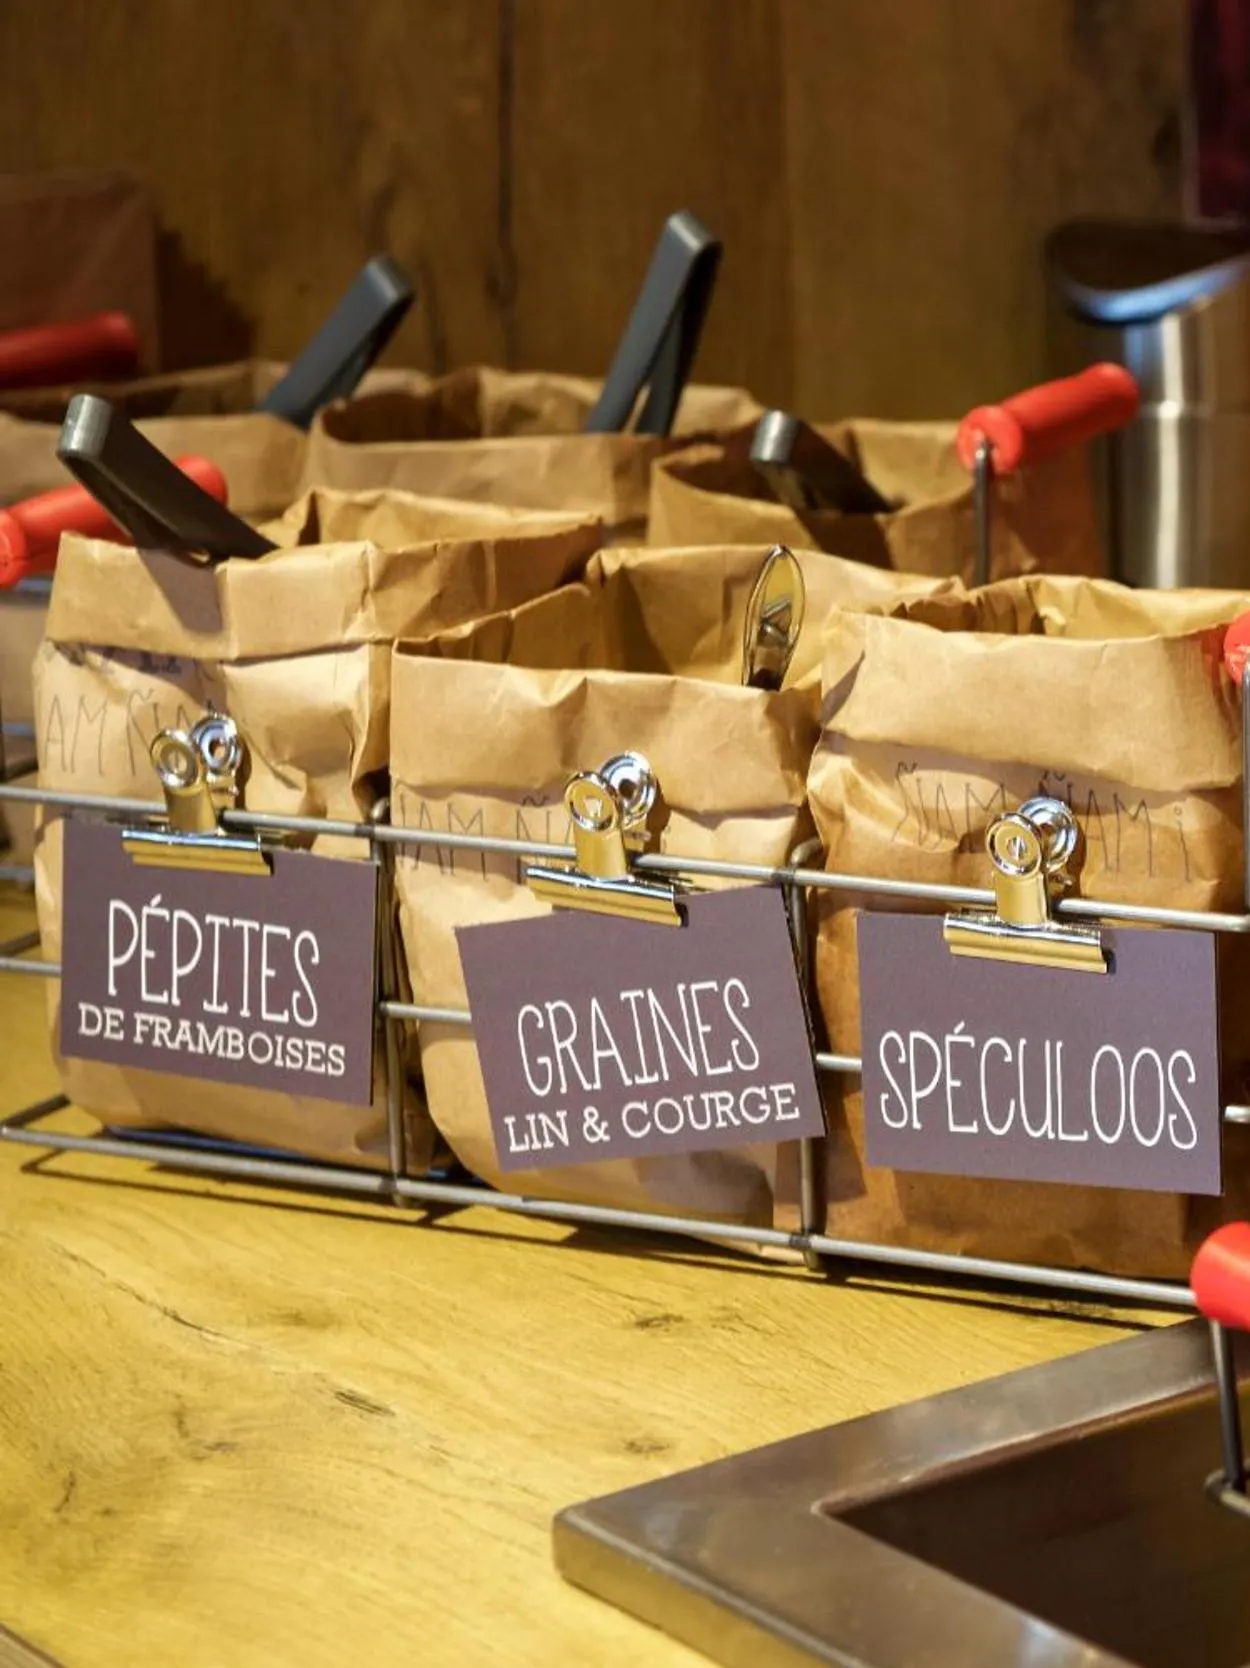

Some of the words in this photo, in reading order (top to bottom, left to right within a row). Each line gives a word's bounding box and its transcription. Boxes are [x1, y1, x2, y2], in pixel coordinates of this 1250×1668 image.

[107, 893, 320, 1028] PÉPITES
[78, 1001, 125, 1041] DE
[133, 1011, 346, 1077] FRAMBOISES
[517, 978, 760, 1097] GRAINES
[879, 1021, 1198, 1150] SPÉCULOOS
[504, 1110, 571, 1153] LIN
[582, 1105, 610, 1144] &
[621, 1083, 801, 1138] COURGE
